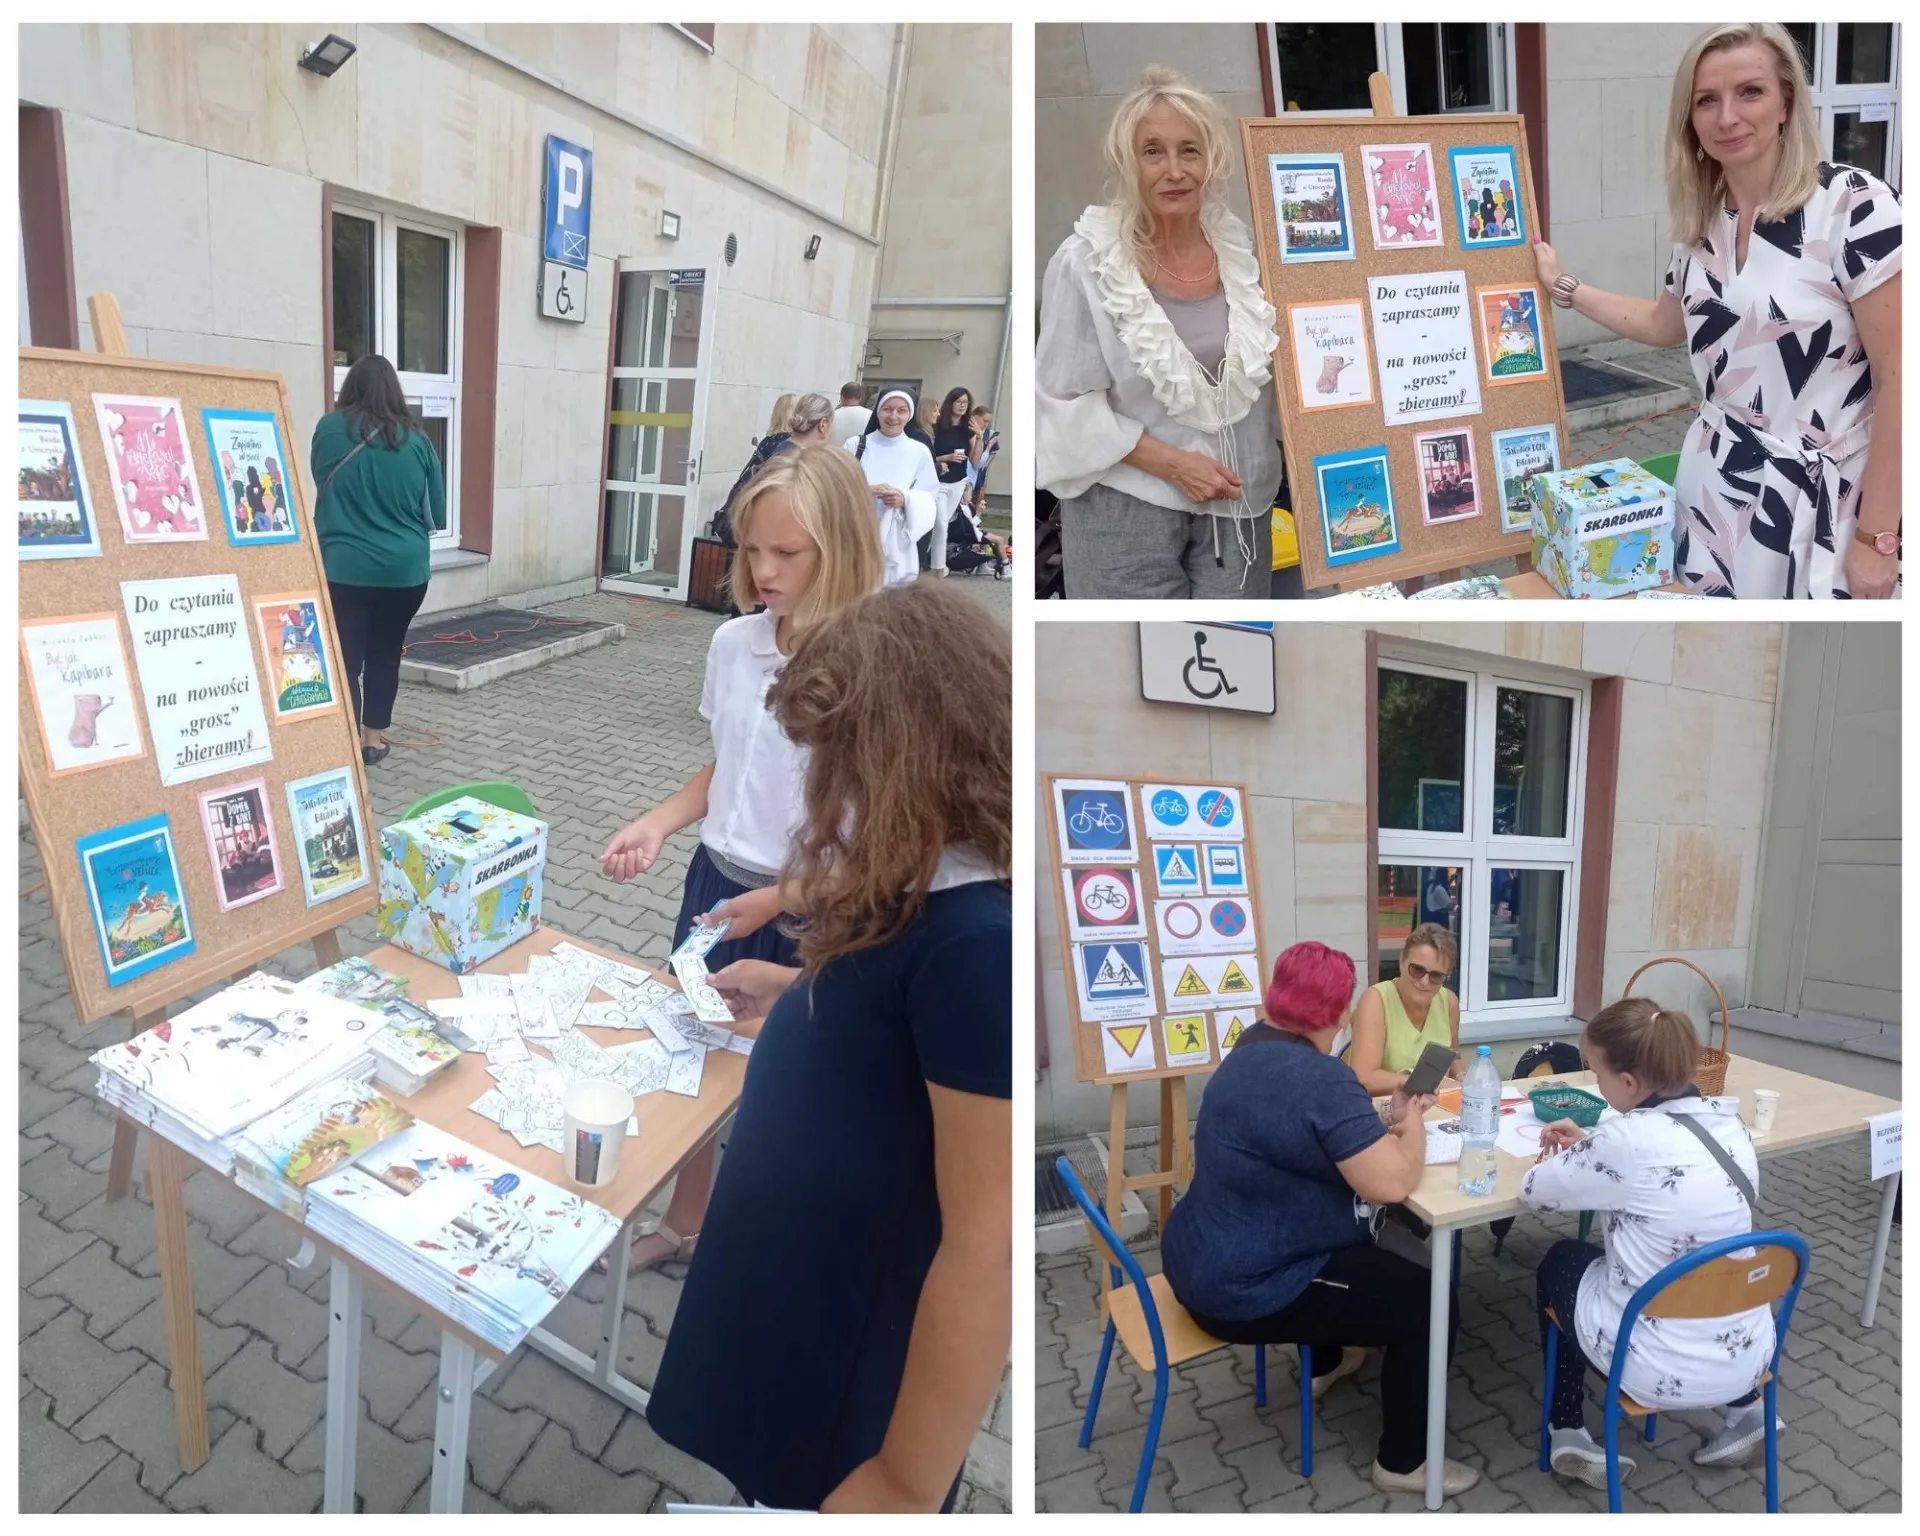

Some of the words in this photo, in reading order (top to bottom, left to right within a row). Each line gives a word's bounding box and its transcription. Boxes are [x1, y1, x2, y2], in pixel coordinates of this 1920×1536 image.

[557, 149, 583, 226] P
[1376, 286, 1396, 300] Do
[1405, 281, 1460, 300] czytania
[1382, 305, 1461, 324] zapraszamy
[1386, 358, 1404, 369] na
[1412, 347, 1467, 365] nowości
[1403, 370, 1456, 391] „grosz”
[1398, 388, 1467, 412] zbieramy!
[1582, 504, 1664, 534] SKARBONKA
[134, 595, 159, 613] Do
[170, 588, 234, 613] czytania
[144, 620, 237, 646] zapraszamy
[156, 693, 177, 708] na
[187, 675, 250, 702] nowości
[180, 706, 239, 737] „grosz”
[175, 730, 253, 766] zbieramy!
[475, 843, 538, 886] SKARBONKA
